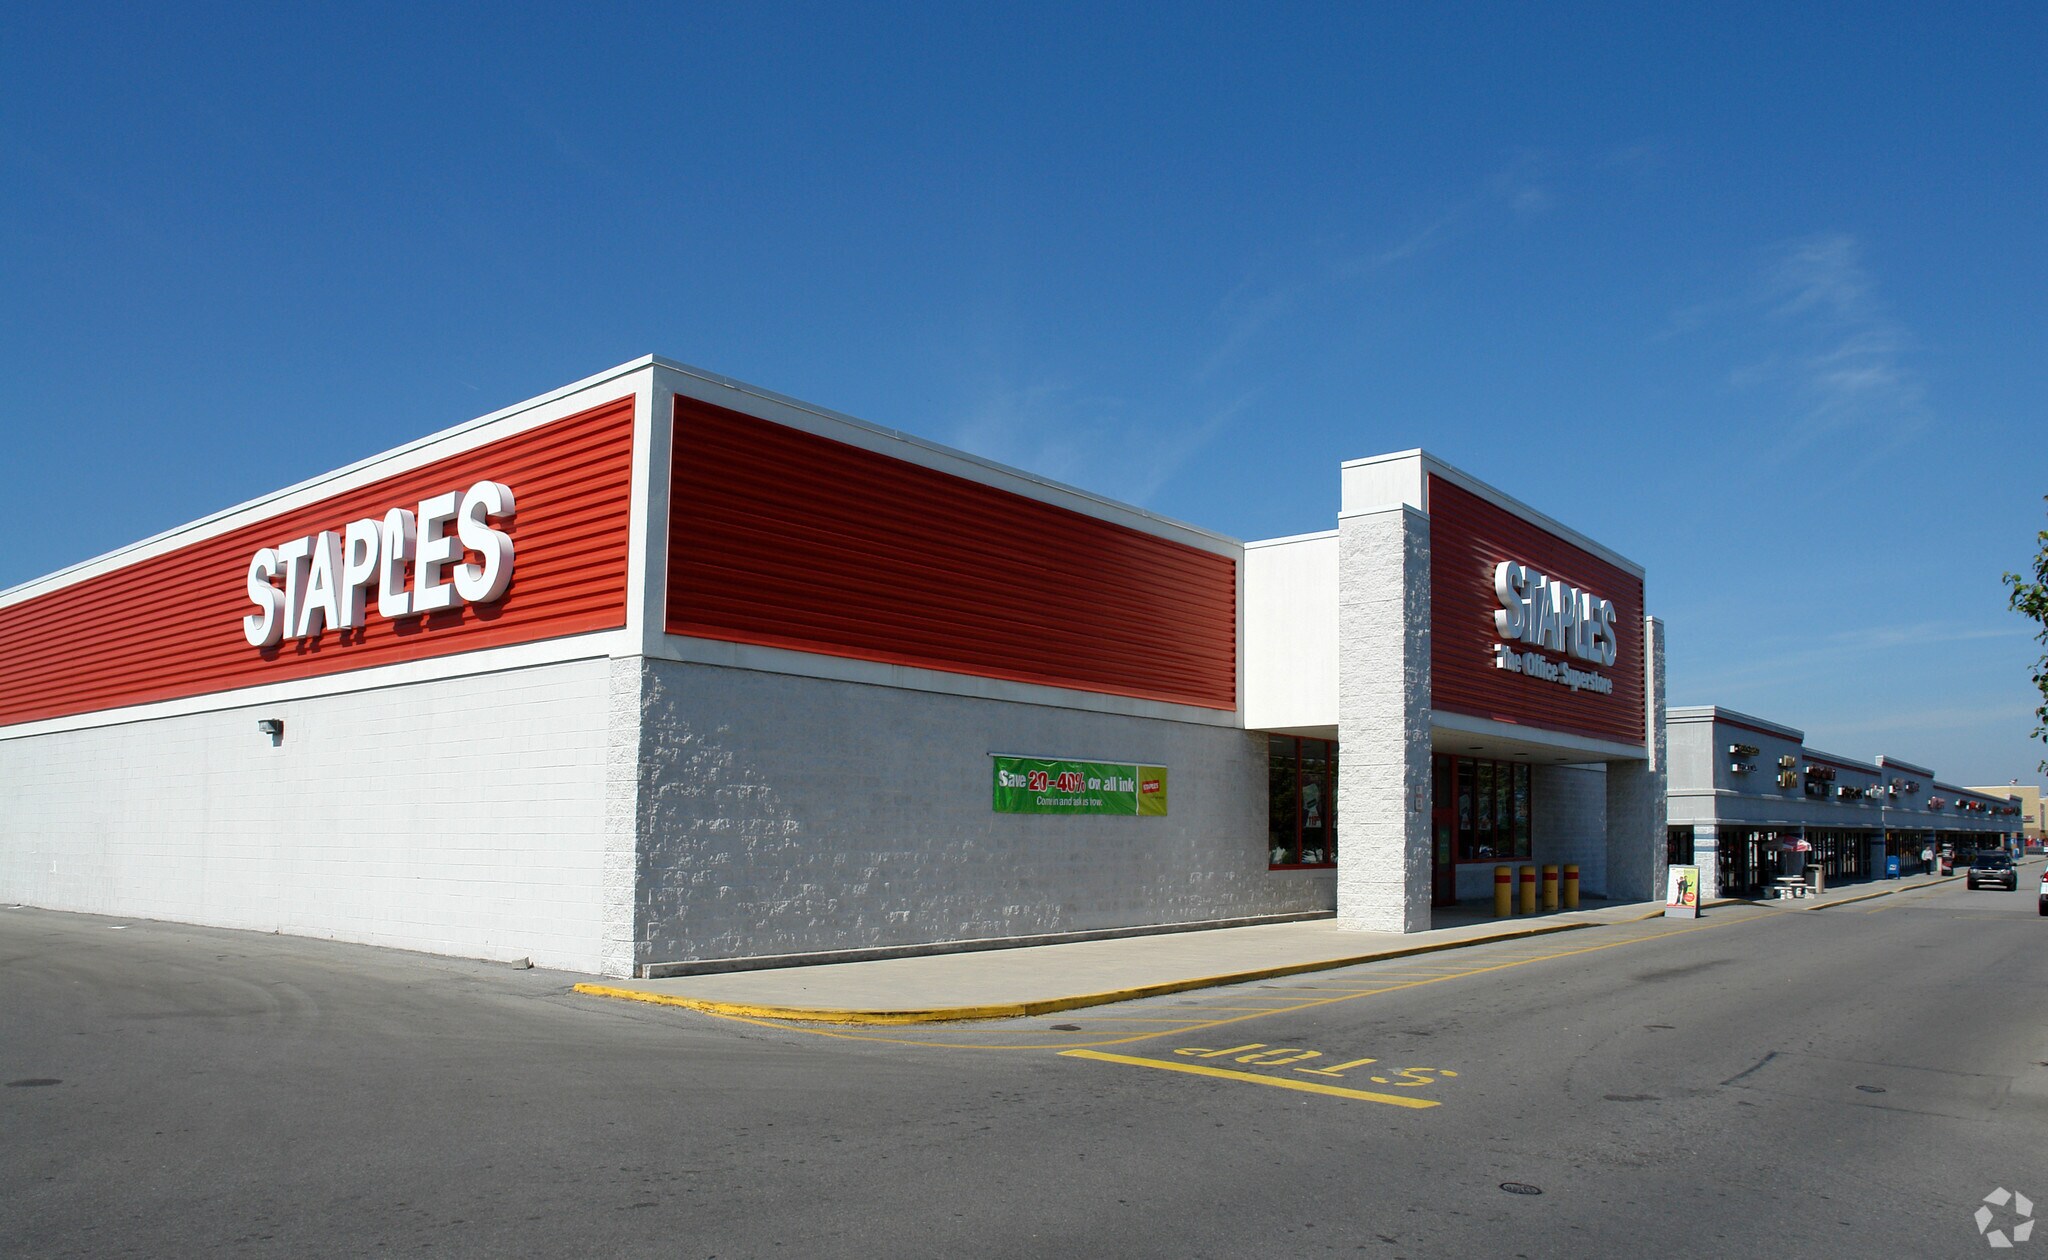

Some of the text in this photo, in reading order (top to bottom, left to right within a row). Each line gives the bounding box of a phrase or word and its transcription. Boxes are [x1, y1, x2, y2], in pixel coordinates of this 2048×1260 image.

[244, 480, 515, 647] STAPLES
[1494, 560, 1617, 667] STAPLES
[1494, 643, 1612, 695] The Office Superstore
[998, 770, 1134, 792] Save 20-40% on all ink
[1059, 797, 1072, 806] and
[1174, 1044, 1458, 1086] STOP
